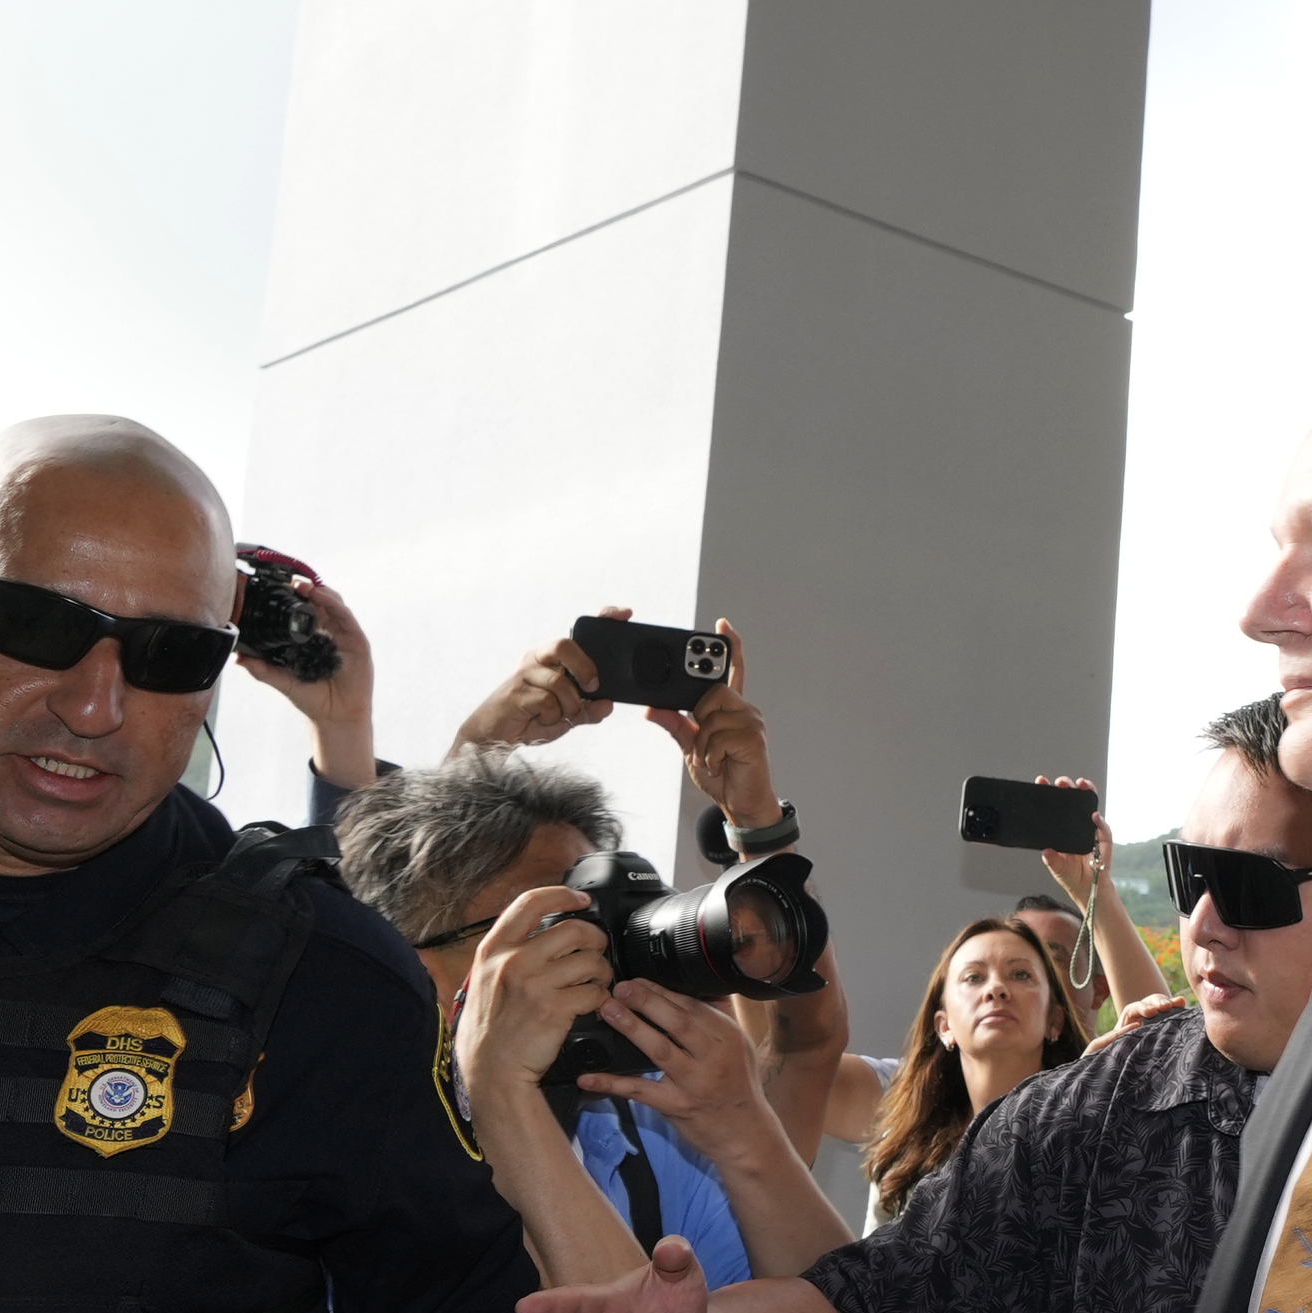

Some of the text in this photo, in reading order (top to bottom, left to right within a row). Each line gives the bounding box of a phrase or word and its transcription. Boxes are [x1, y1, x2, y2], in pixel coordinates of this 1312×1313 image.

[628, 871, 660, 881] Canon
[106, 1036, 144, 1051] DHS
[85, 1127, 133, 1141] POLICE
